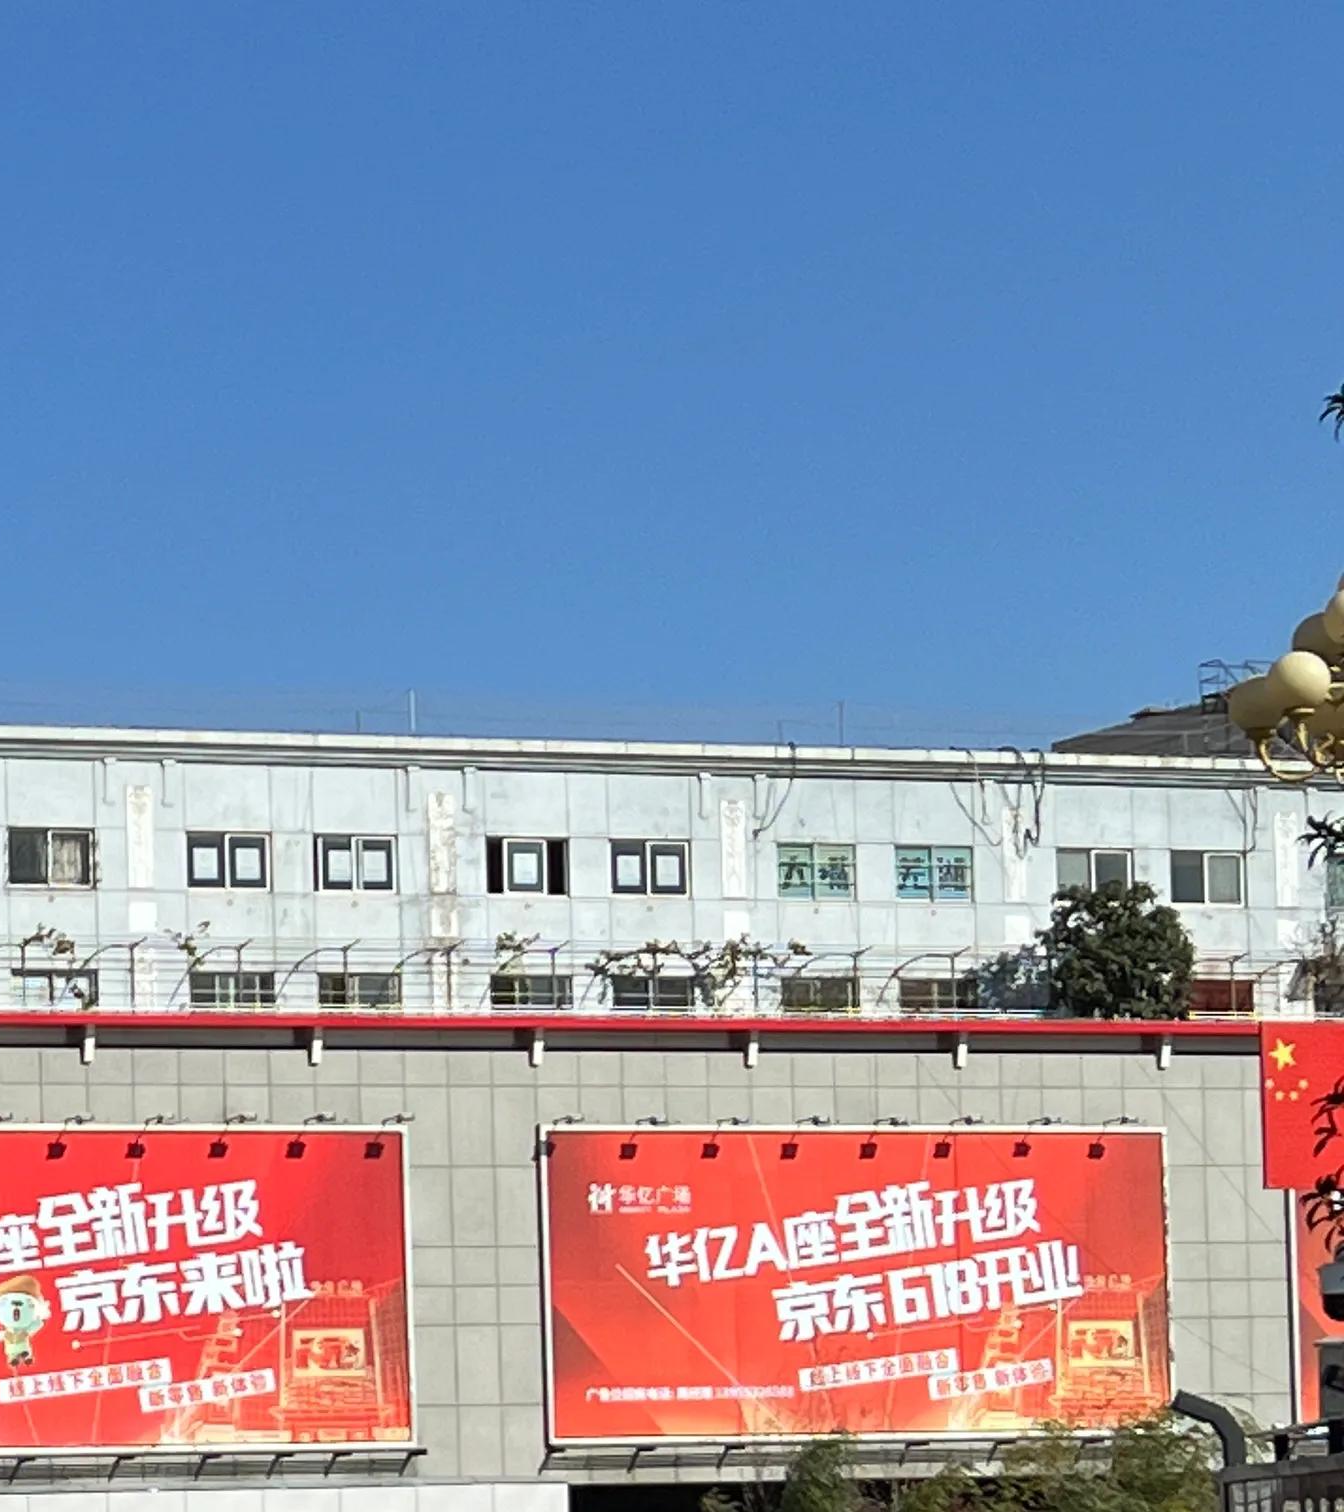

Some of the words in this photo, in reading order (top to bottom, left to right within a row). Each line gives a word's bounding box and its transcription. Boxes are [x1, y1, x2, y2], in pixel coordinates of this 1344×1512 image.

[644, 1178, 1041, 1289] 华亿A座全新升级
[55, 1243, 315, 1333] 京东来啦
